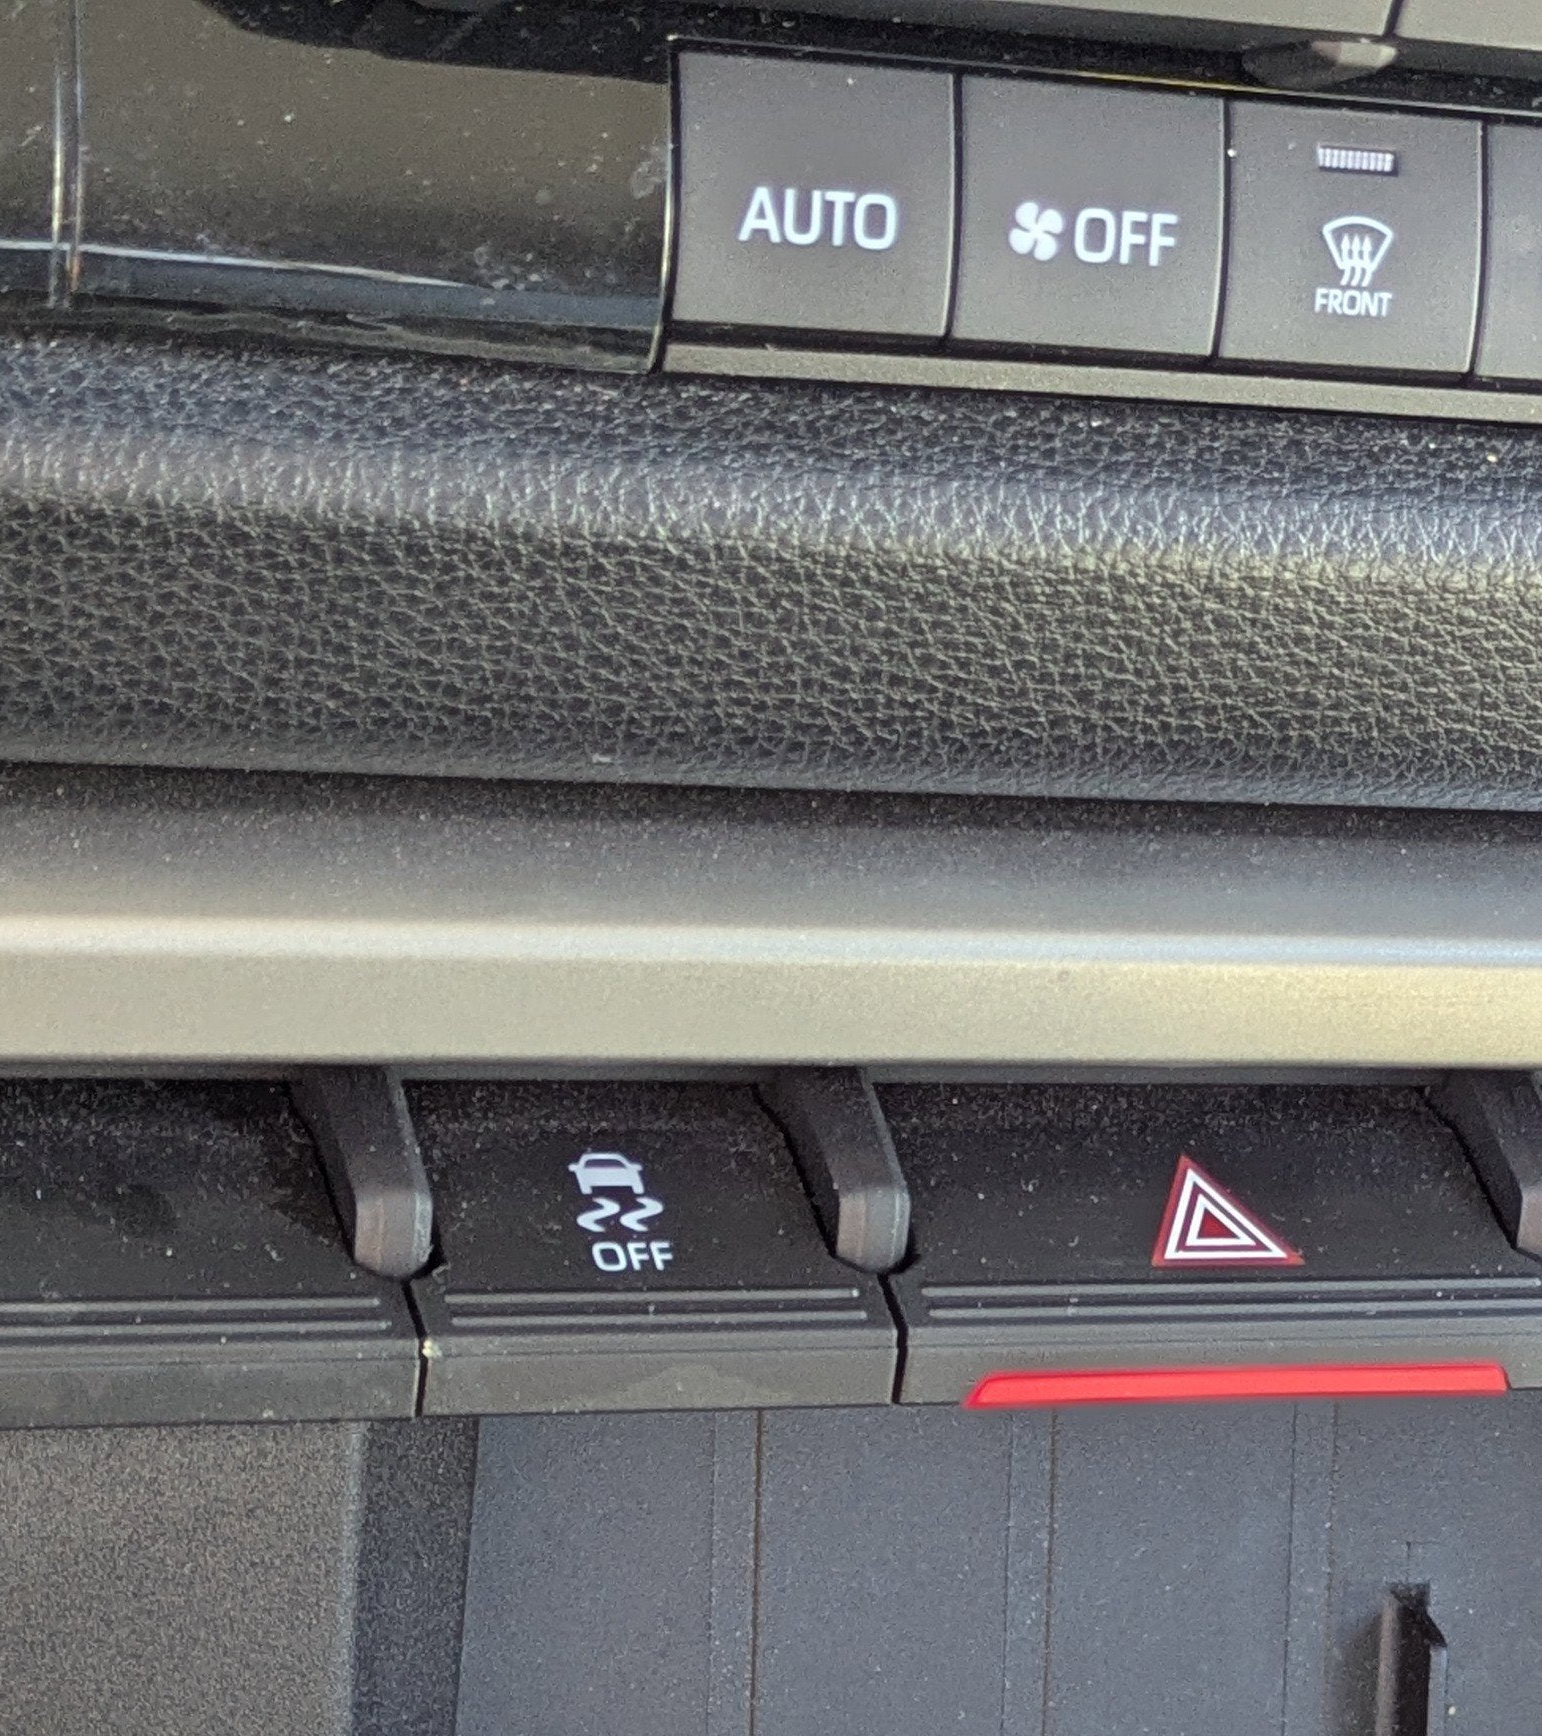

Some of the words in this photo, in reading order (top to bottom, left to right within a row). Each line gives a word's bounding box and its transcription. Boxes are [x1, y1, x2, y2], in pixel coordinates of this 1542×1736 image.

[737, 186, 899, 252] AUTO
[1073, 207, 1180, 268] OFF
[1313, 287, 1393, 318] FRONT
[591, 1239, 673, 1273] OFF
